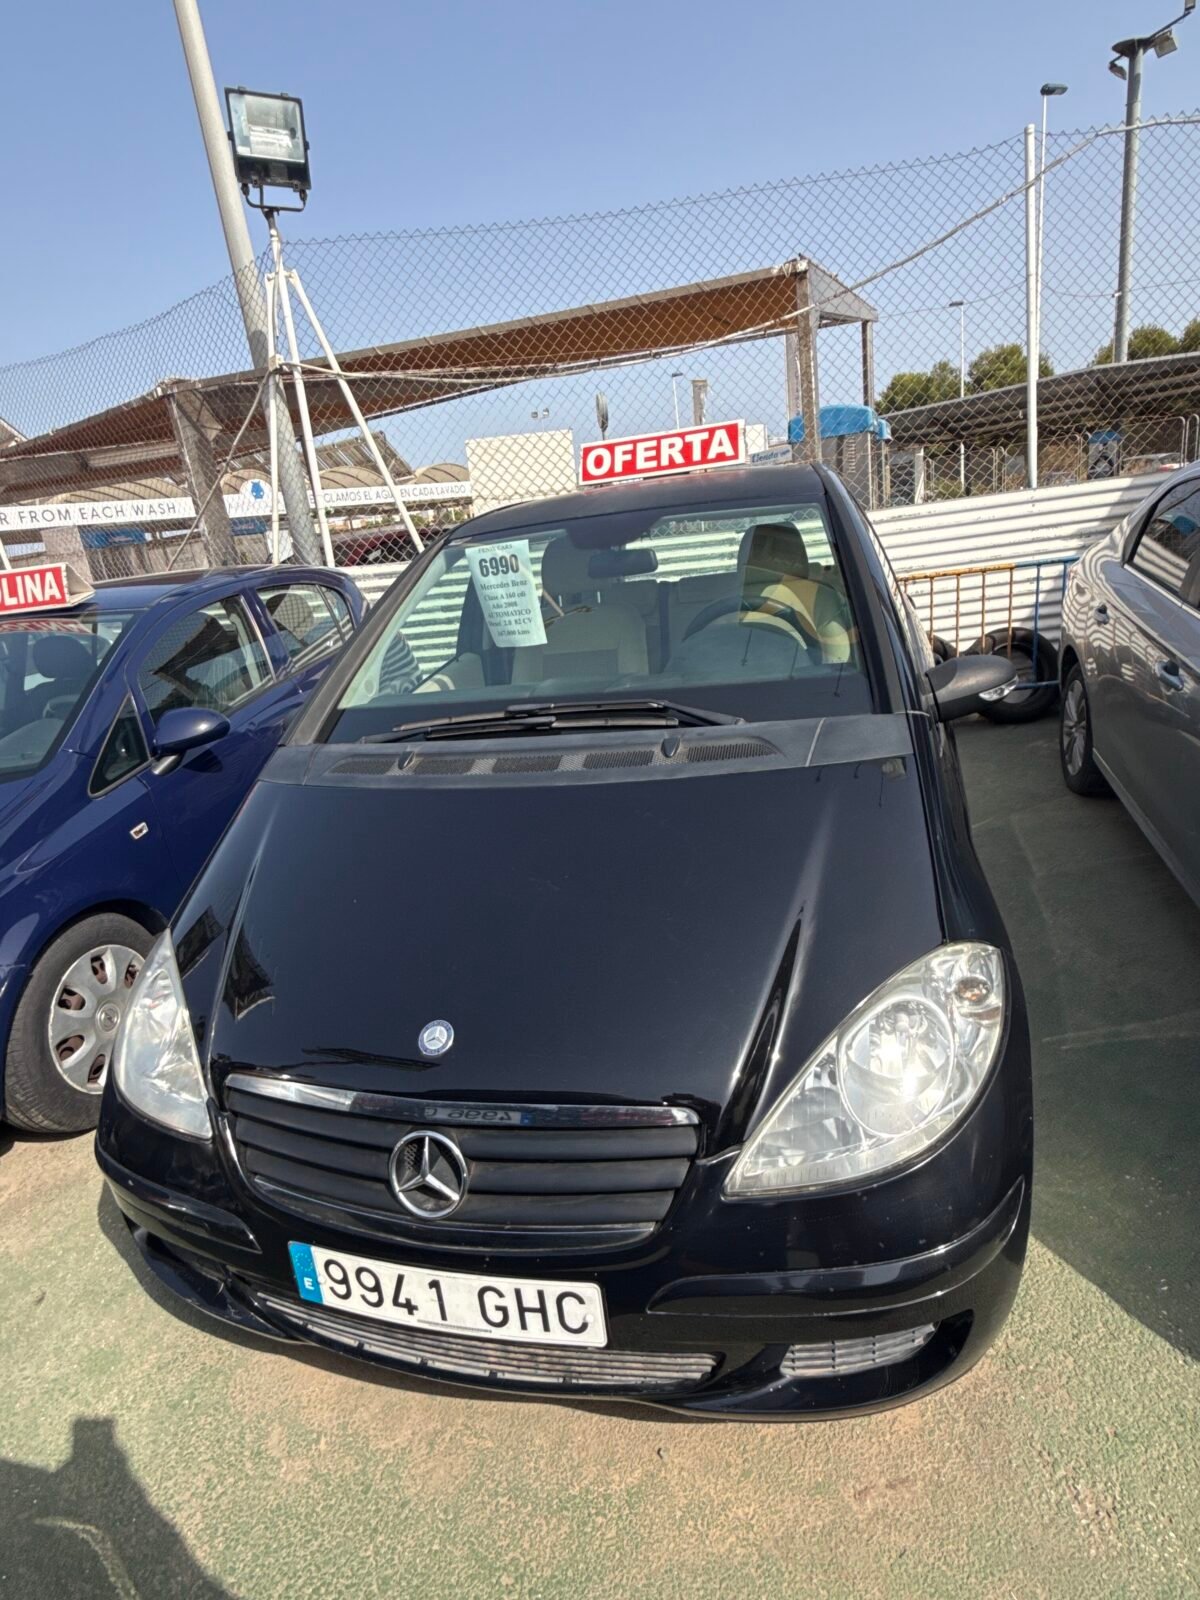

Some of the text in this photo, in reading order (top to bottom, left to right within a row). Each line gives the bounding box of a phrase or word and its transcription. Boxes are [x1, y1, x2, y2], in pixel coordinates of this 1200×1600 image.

[587, 429, 735, 476] OFERTA
[376, 489, 396, 500] AGU
[400, 488, 411, 499] EN
[413, 486, 435, 498] CADA
[18, 508, 72, 524] FROM
[78, 504, 125, 520] EACH
[133, 502, 177, 516] WASH
[479, 554, 519, 577] 6990
[0, 571, 63, 606] LINA
[480, 579, 527, 590] Mercedes Benz
[303, 1258, 590, 1335] E 9941 GHC
